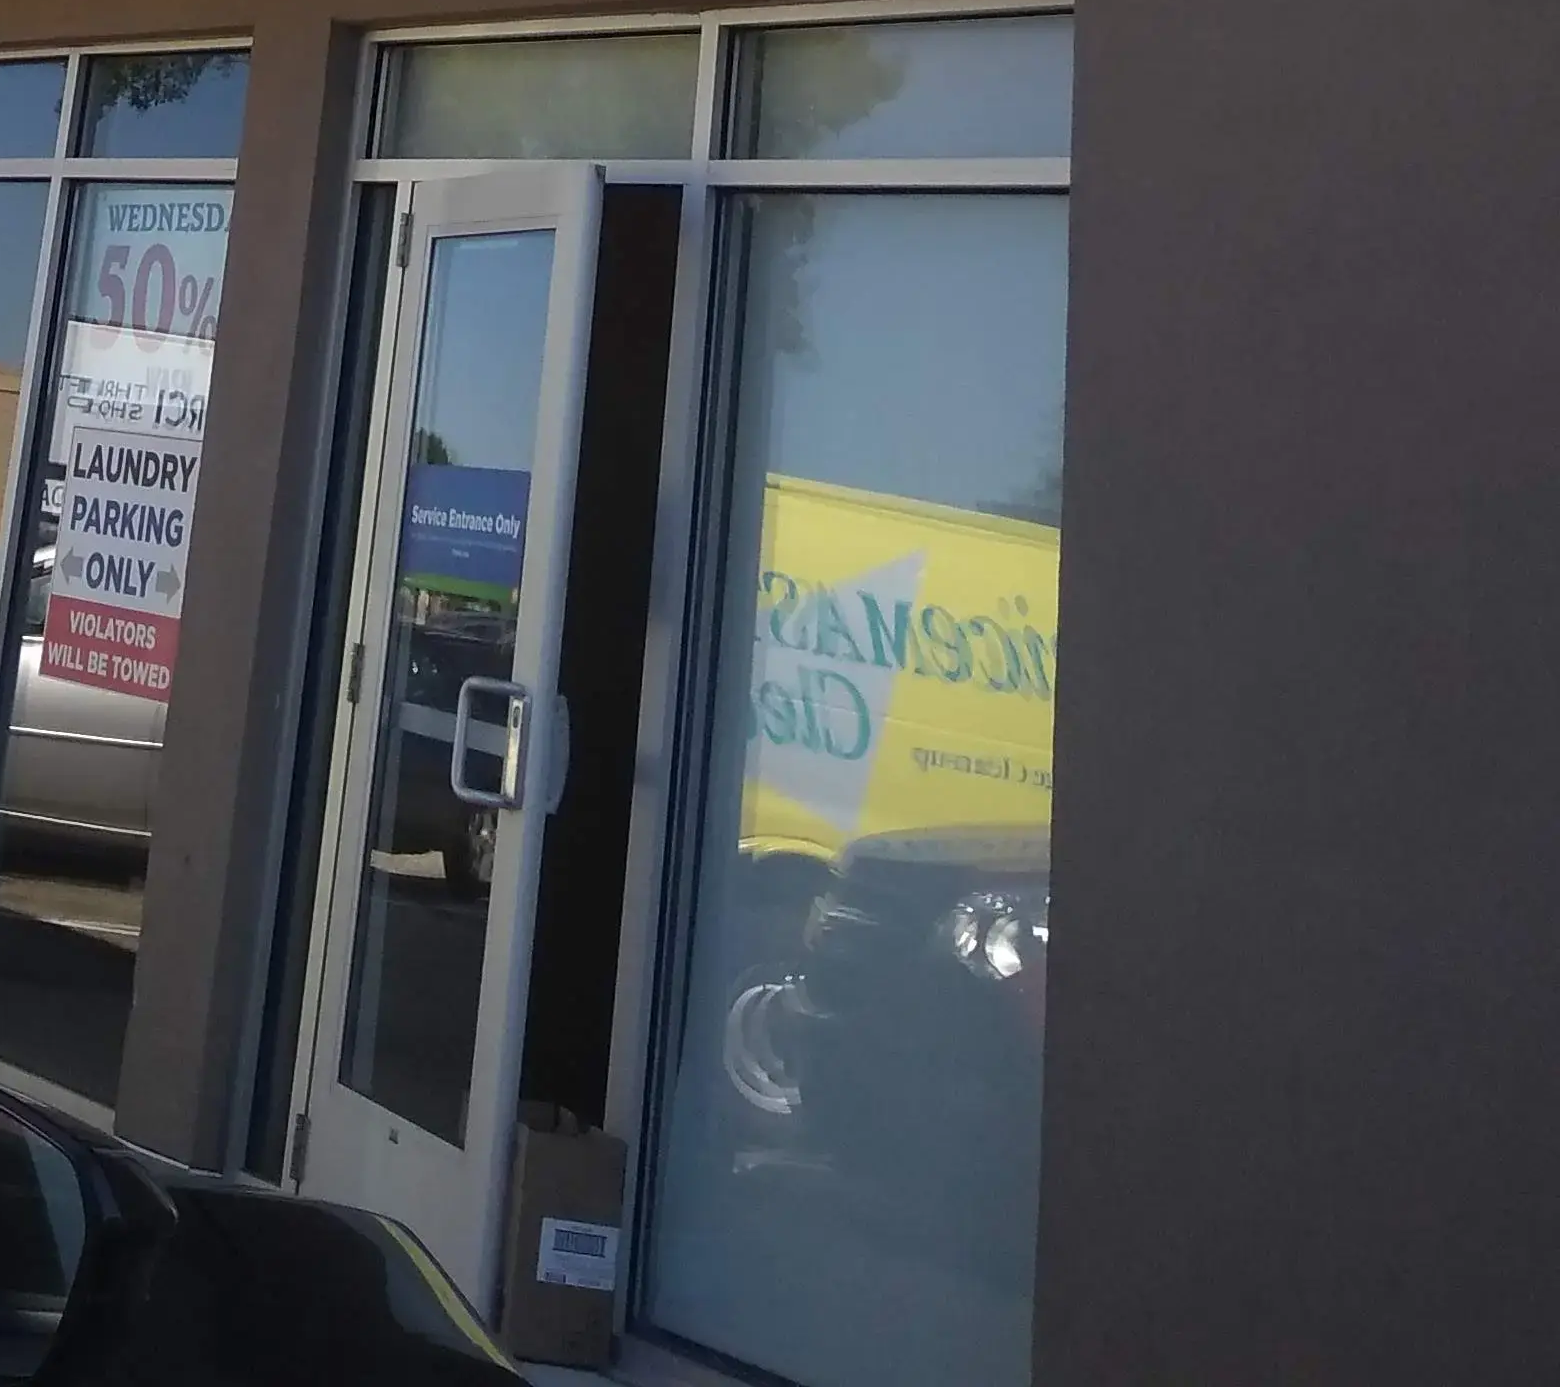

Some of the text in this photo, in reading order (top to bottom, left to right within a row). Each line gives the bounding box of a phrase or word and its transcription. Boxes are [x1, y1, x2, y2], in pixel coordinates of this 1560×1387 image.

[108, 202, 229, 233] WEDNESD
[73, 442, 198, 493] LAUNDRY
[70, 494, 184, 548] PARKING
[411, 505, 521, 539] Service Entrance Only
[85, 552, 156, 598] ONLY
[69, 610, 156, 650] VIOLATORS
[47, 641, 170, 690] WILL BE TOWED
